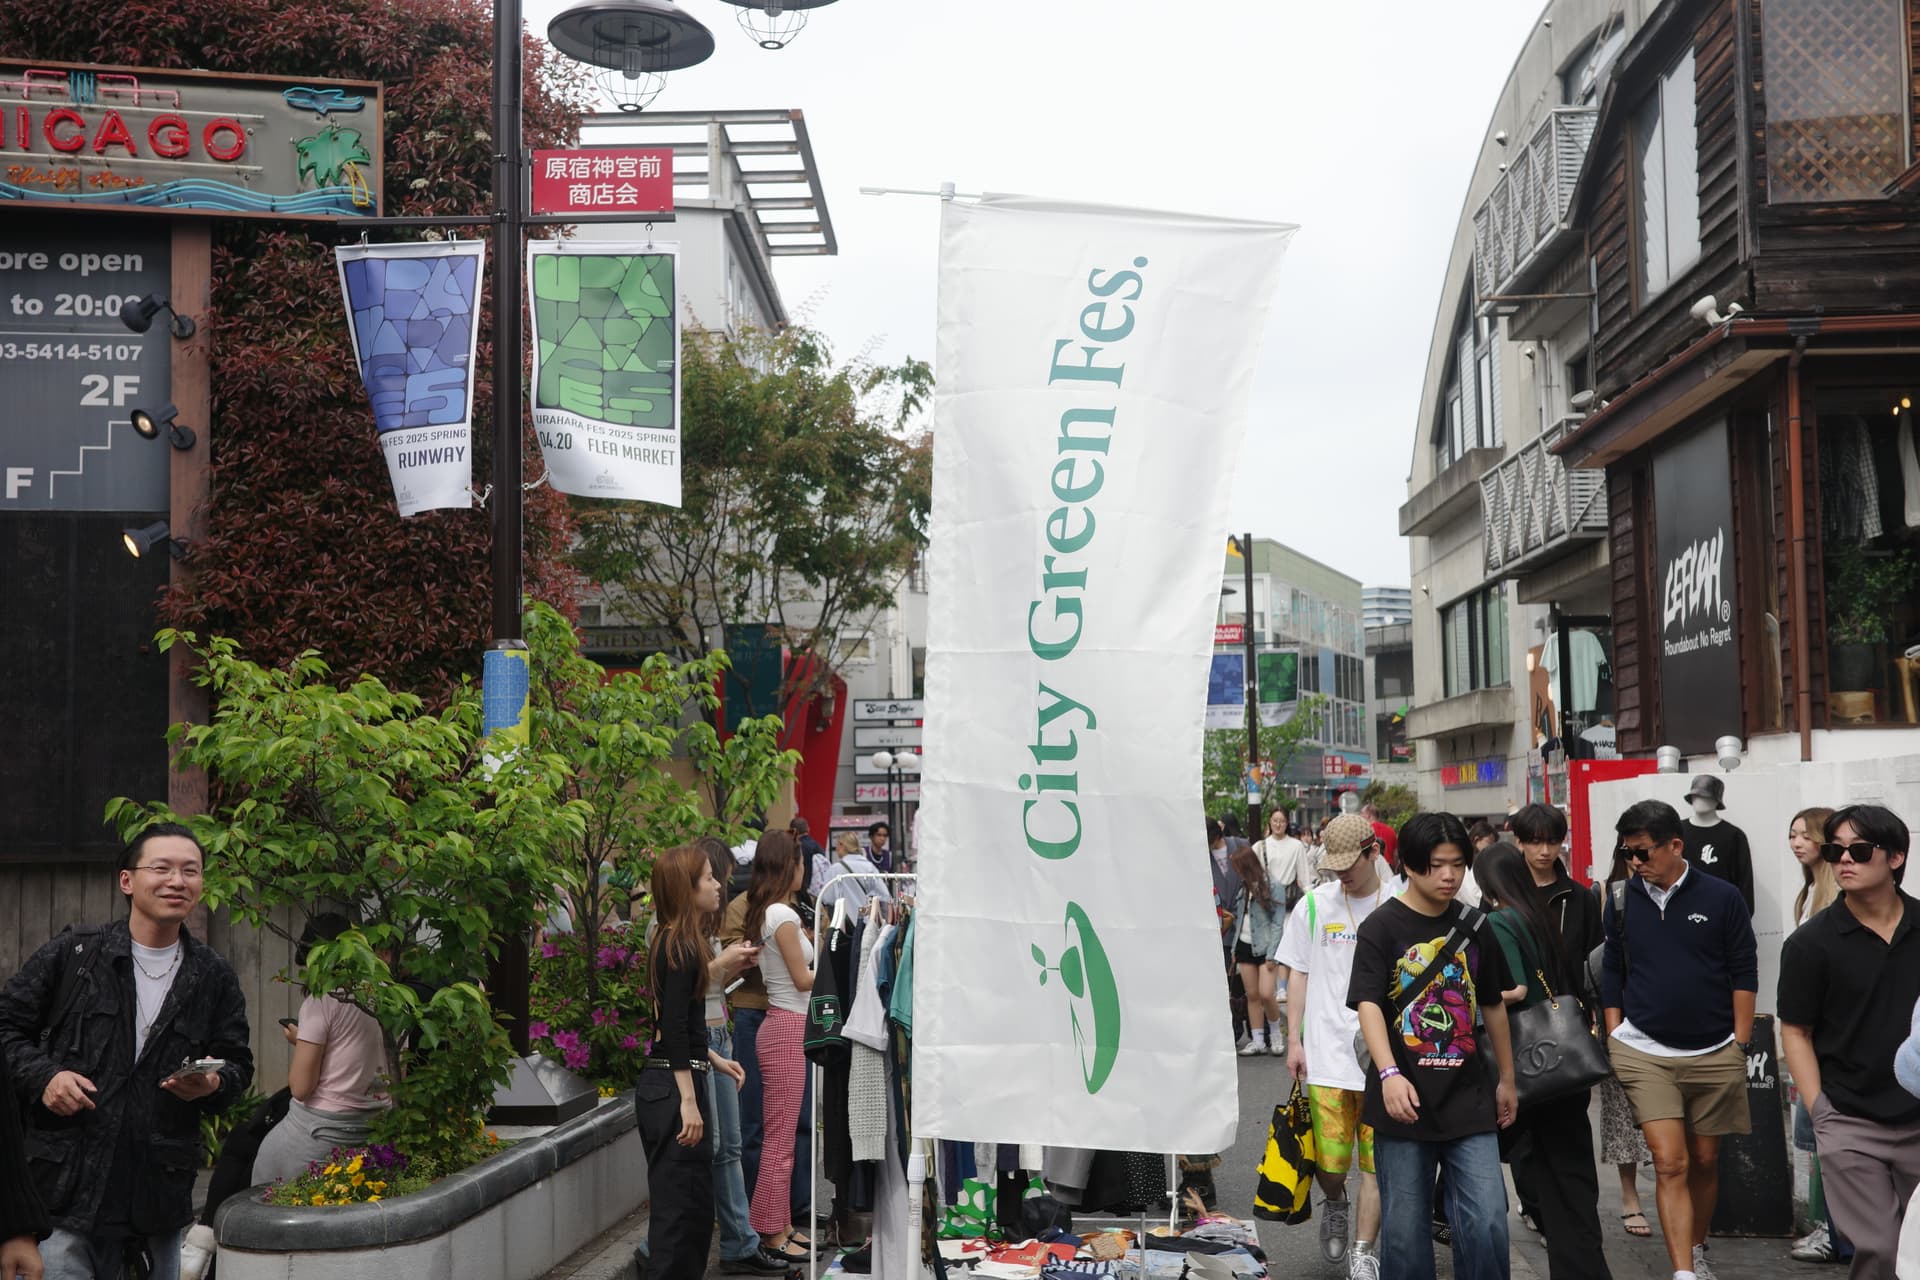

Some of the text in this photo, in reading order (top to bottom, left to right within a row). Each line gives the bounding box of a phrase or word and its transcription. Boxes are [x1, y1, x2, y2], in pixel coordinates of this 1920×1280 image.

[545, 156, 661, 179] 原宿神宮前
[568, 182, 638, 206] 商店会
[59, 253, 143, 276] open
[11, 294, 44, 315] to
[1048, 255, 1148, 388] Fes.
[79, 374, 141, 406] 2F
[406, 433, 428, 444] 2025
[430, 428, 467, 441] SPRING
[536, 414, 676, 444] URAHARA FES 2025 SPRING
[398, 446, 465, 469] RUNWAY
[588, 438, 618, 457] FLEA
[622, 443, 676, 466] MARKET
[1026, 405, 1117, 661] Green
[1664, 625, 1732, 656] Roundabout No Regret
[1018, 681, 1097, 860] City
